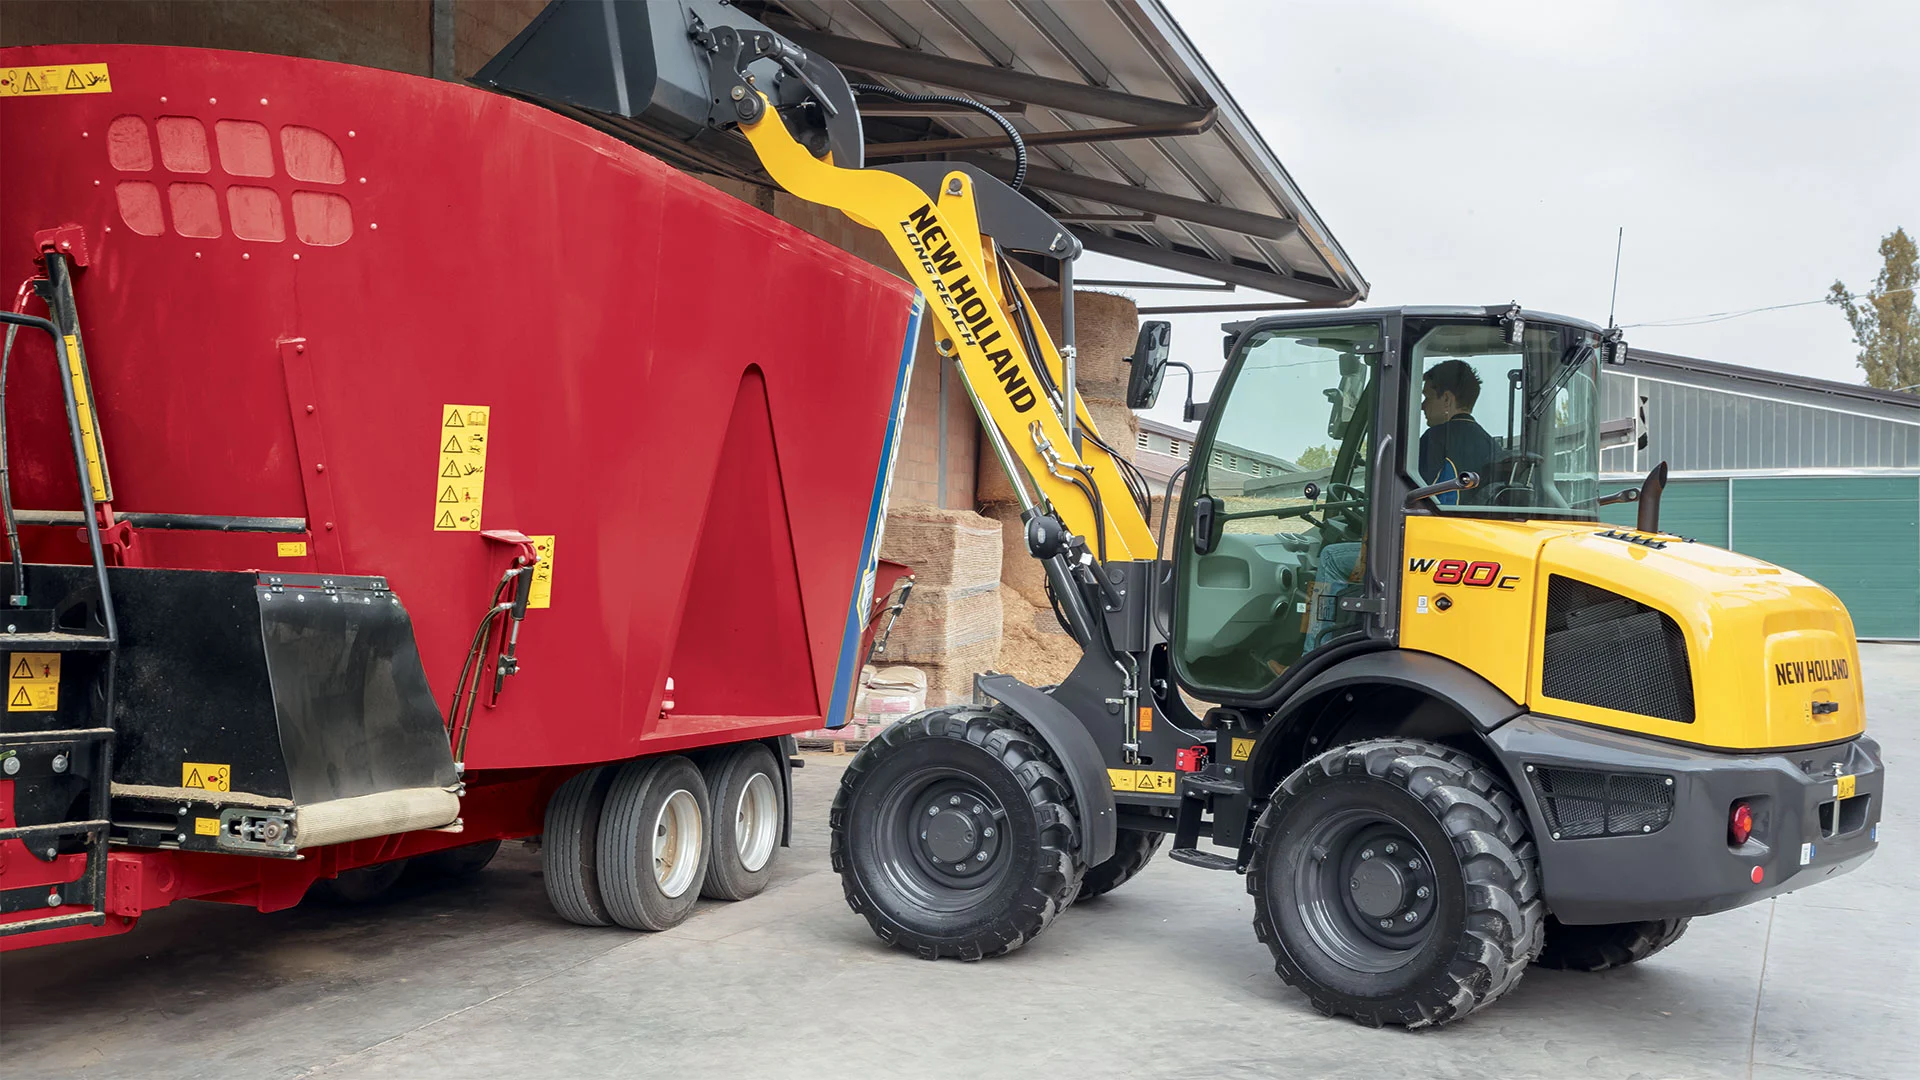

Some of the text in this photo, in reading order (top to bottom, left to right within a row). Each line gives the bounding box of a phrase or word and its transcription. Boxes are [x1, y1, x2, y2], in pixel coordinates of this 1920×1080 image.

[900, 220, 977, 346] LONG REACH
[909, 203, 1037, 413] NEW HOLLAND
[1775, 659, 1849, 686] NEW HOLLAND
